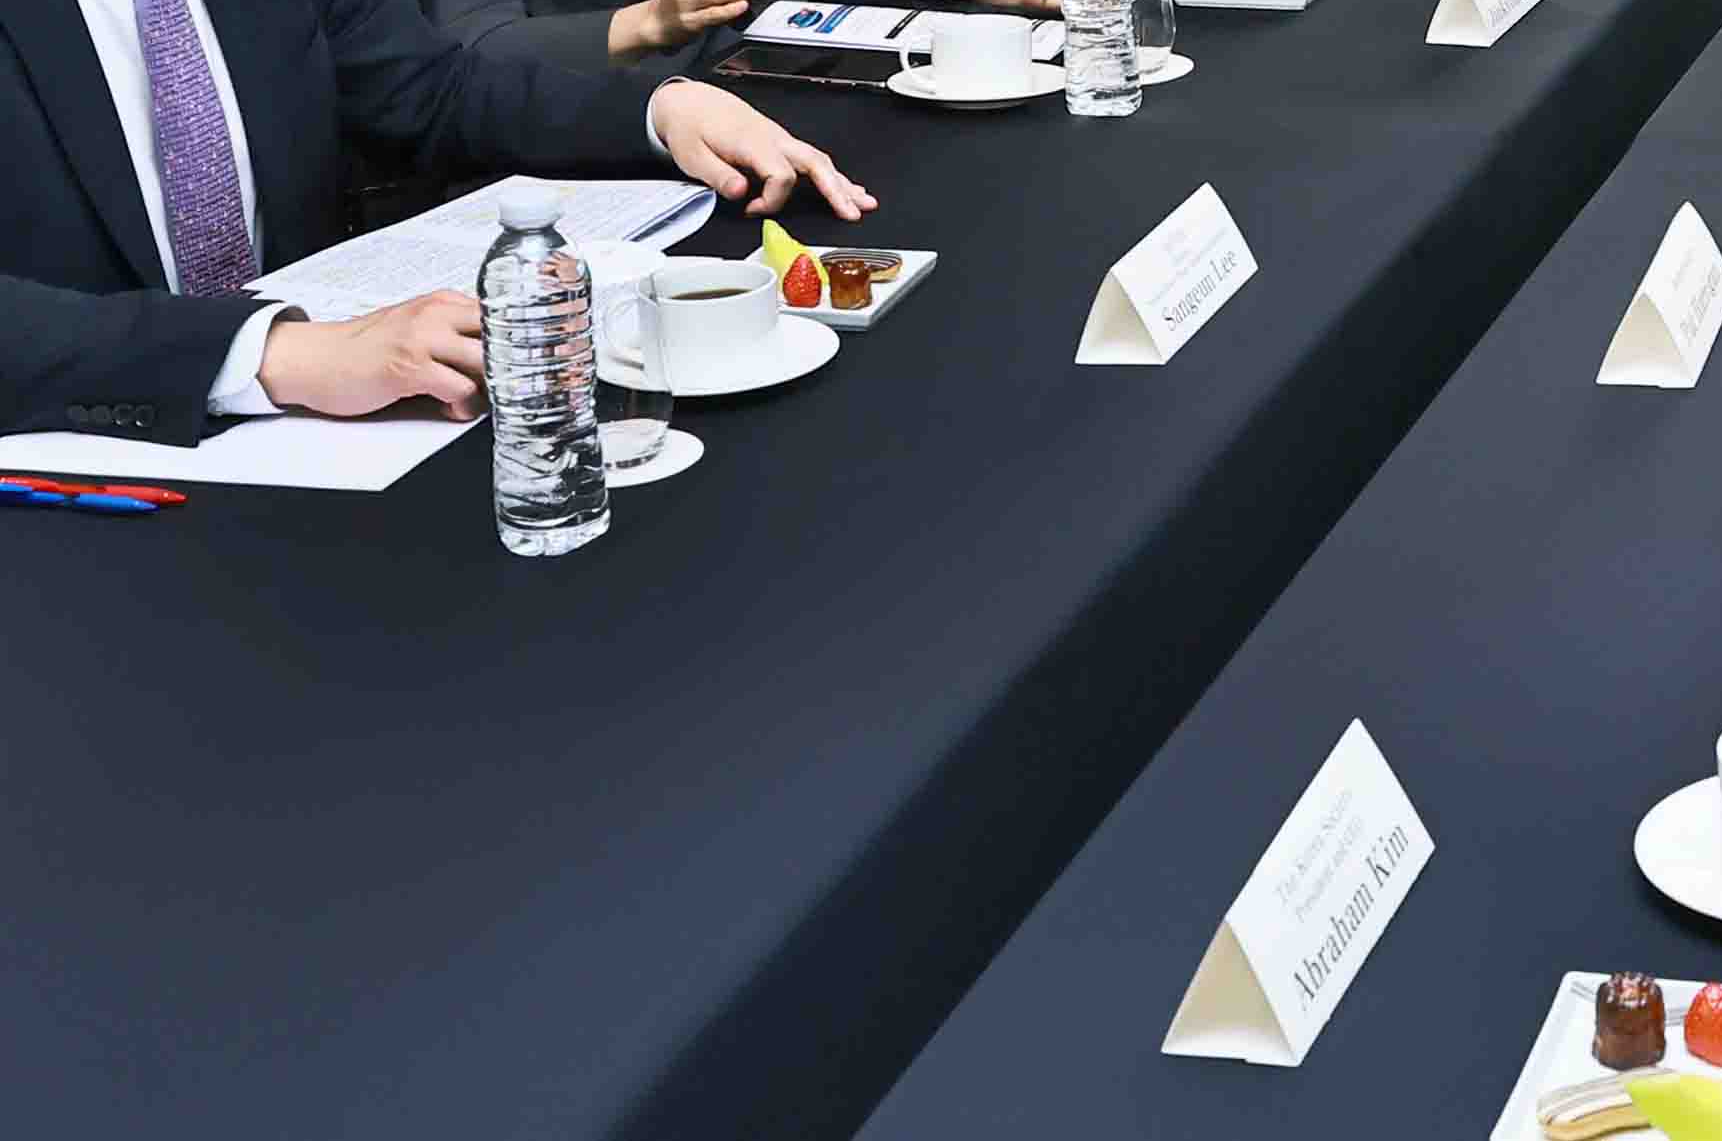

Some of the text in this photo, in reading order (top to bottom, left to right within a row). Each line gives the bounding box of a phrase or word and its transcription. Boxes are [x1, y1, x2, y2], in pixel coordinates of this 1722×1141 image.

[1162, 271, 1216, 331] Sangeun
[1210, 250, 1238, 282] Lee
[1293, 882, 1376, 1011] Abraham
[1364, 825, 1410, 889] Kim
